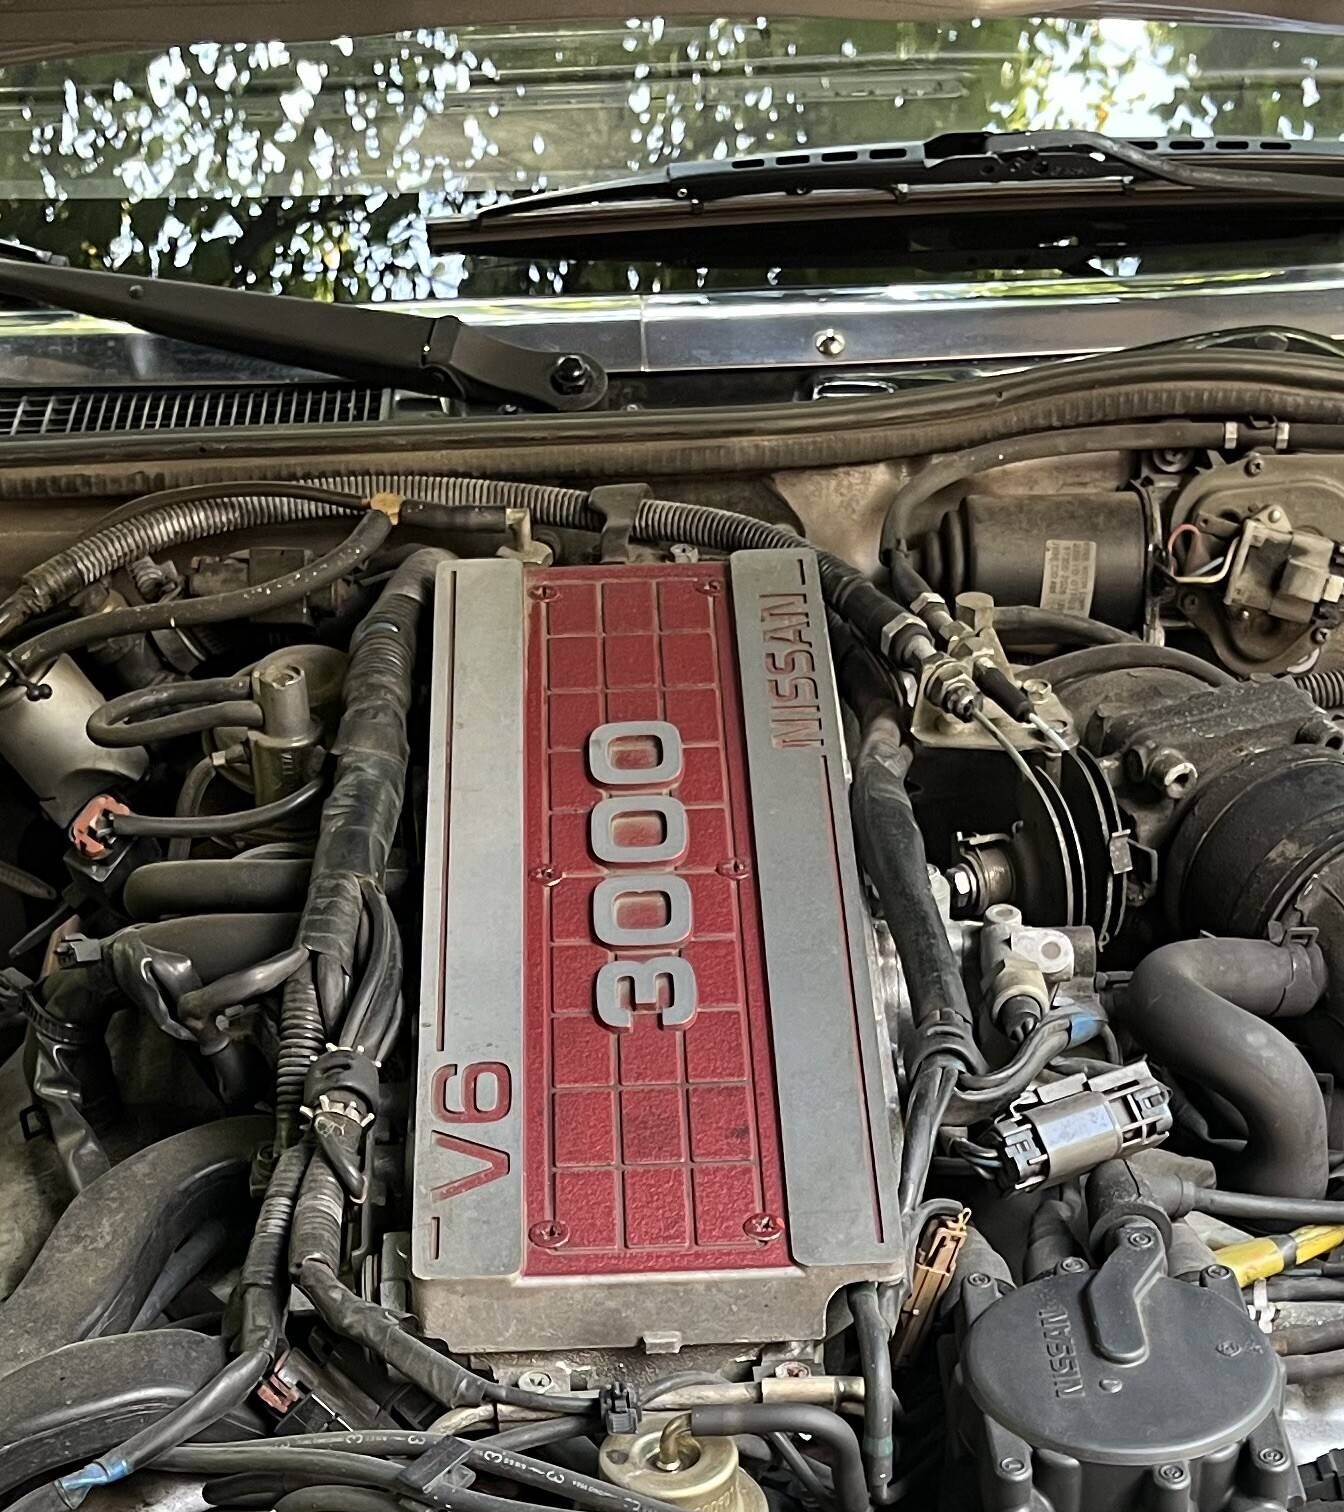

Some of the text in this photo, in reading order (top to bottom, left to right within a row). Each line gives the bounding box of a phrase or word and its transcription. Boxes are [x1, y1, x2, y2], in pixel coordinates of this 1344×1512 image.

[758, 590, 824, 752] NISSAN
[588, 720, 697, 1029] 3000
[430, 1059, 512, 1202] V6
[1037, 1303, 1087, 1400] NISSAN
